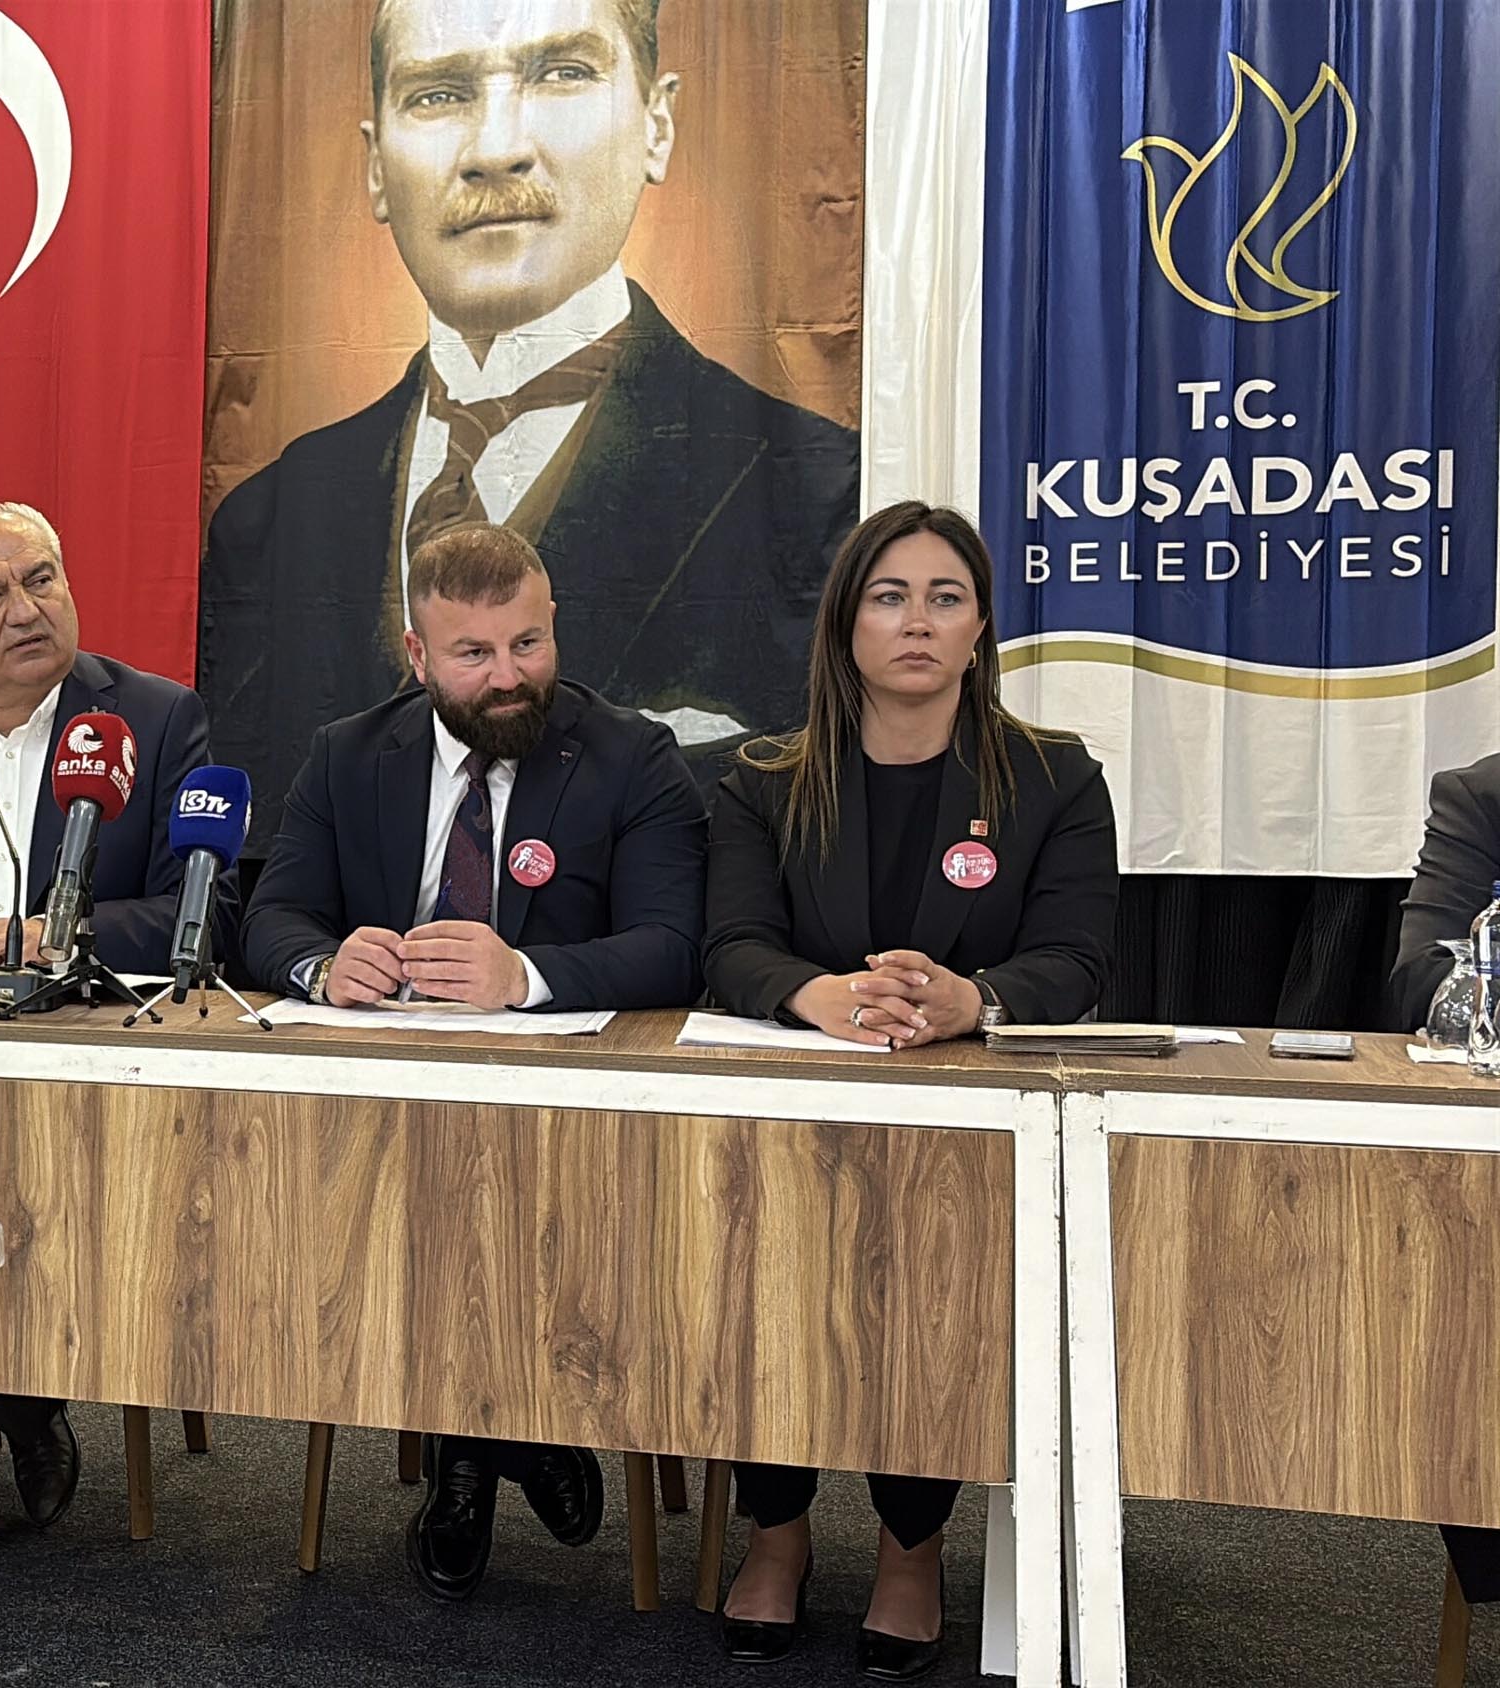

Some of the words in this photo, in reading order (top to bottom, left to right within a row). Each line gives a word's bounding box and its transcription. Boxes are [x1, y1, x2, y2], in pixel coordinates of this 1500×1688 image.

[1178, 379, 1297, 430] T.C.
[1025, 449, 1454, 524] KUŞADASI
[1024, 525, 1451, 585] BELEDİYESİ
[58, 754, 106, 771] anka
